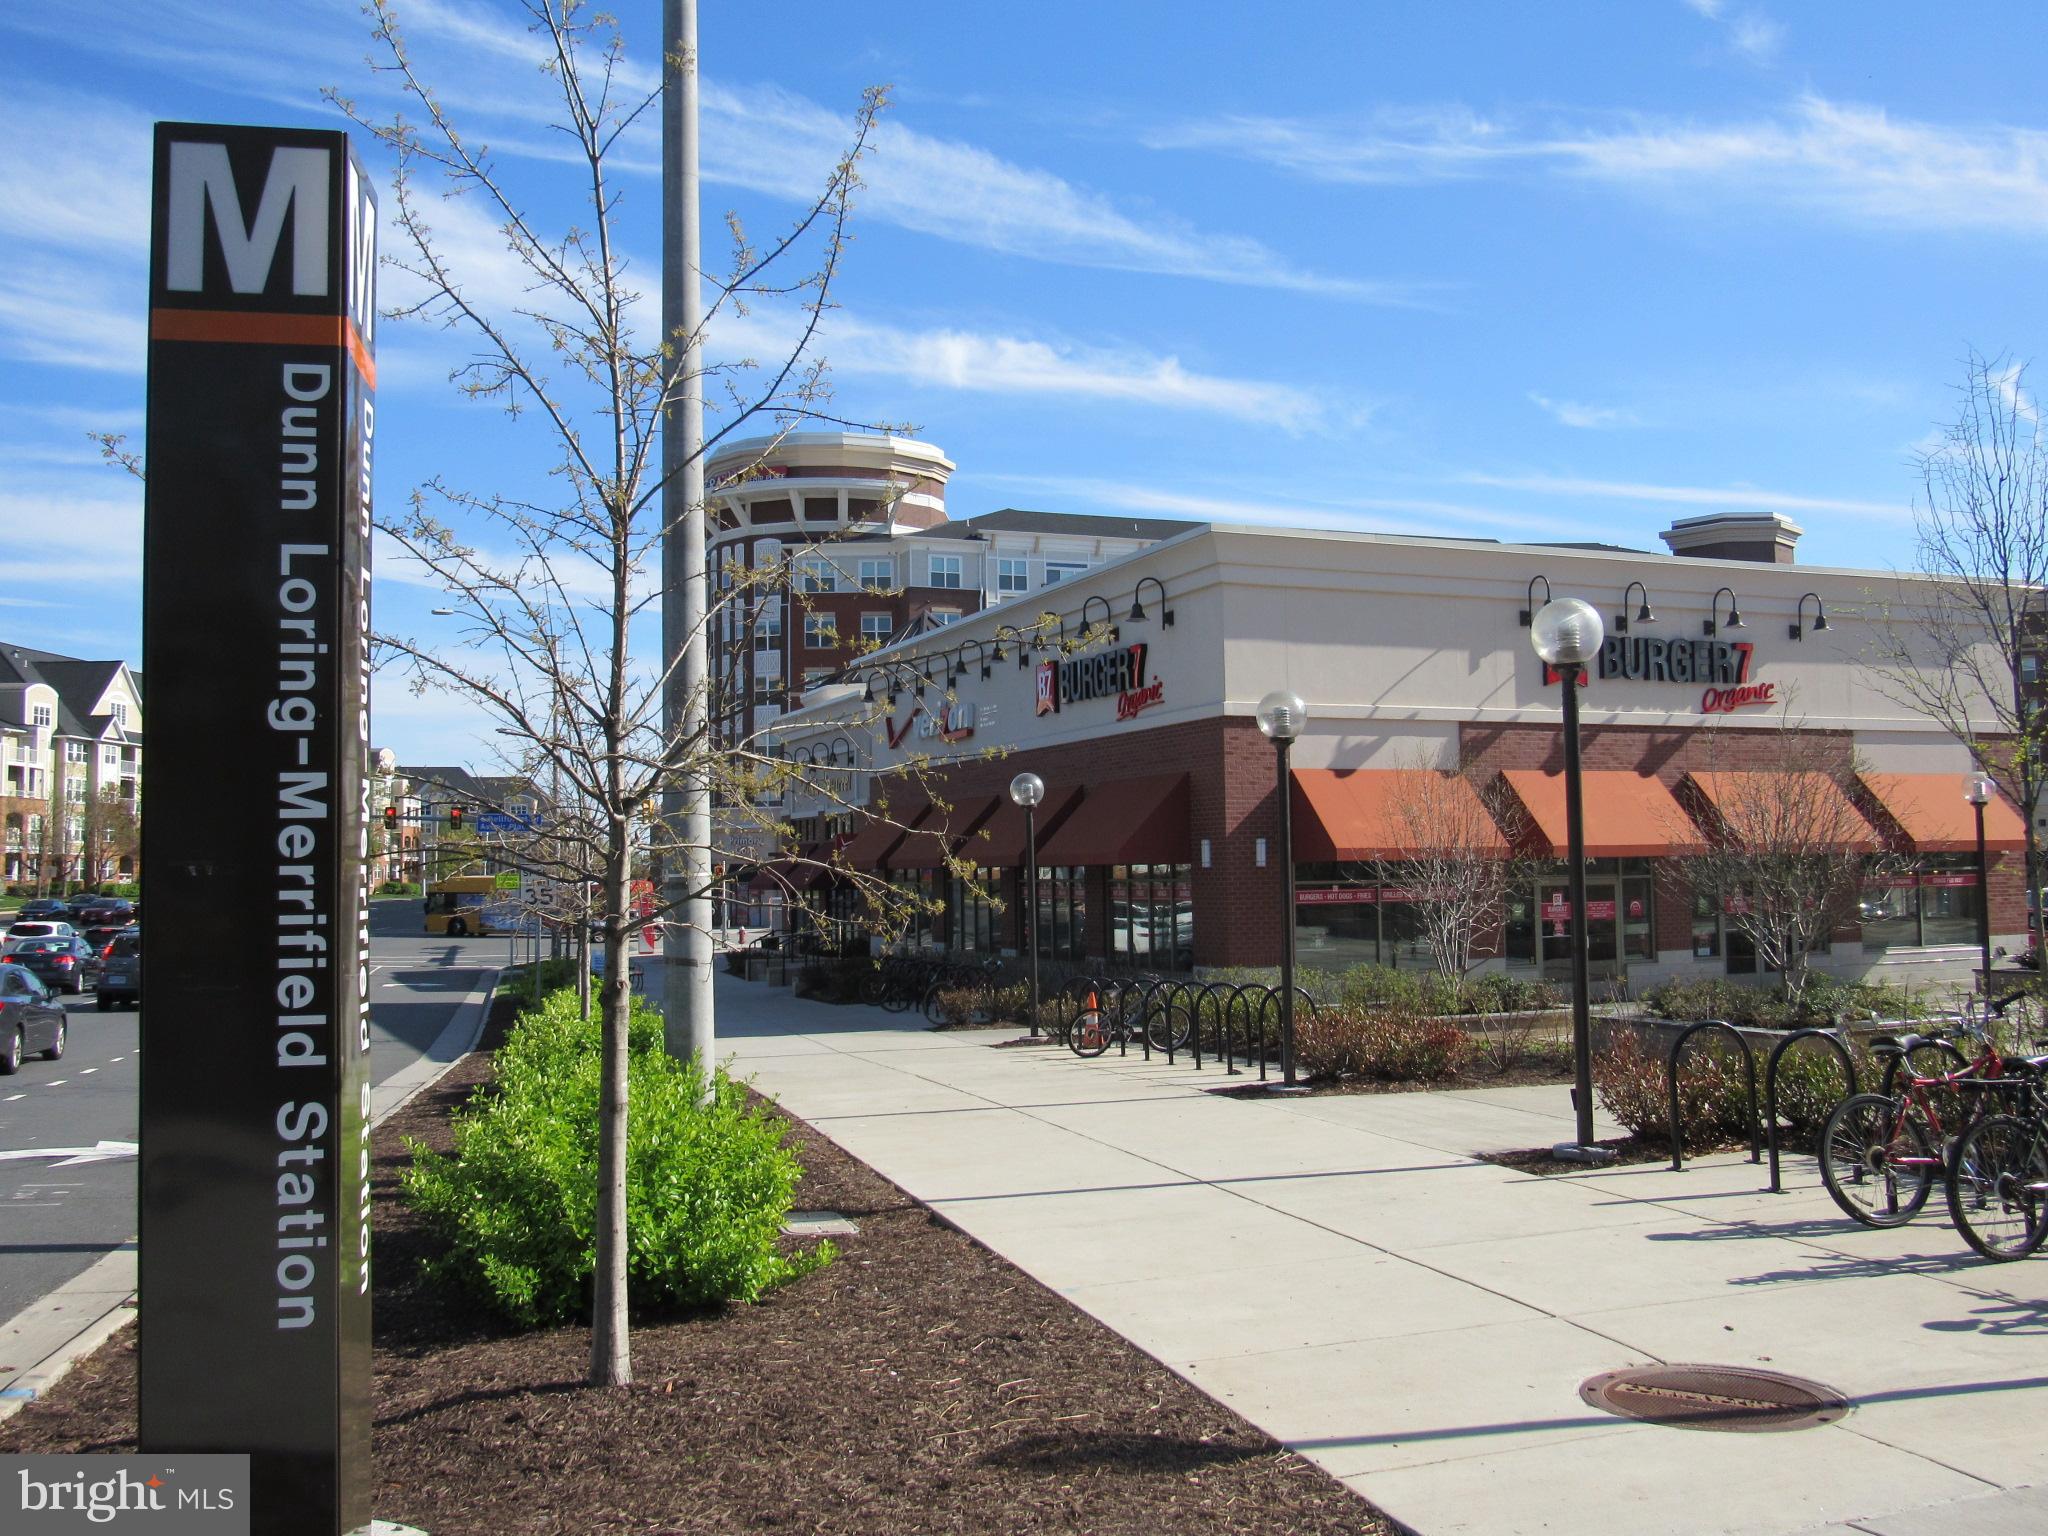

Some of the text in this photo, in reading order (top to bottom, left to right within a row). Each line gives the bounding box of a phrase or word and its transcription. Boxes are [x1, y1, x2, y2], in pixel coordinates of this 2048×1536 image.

[167, 141, 331, 297] M
[349, 159, 376, 343] M
[281, 363, 331, 511] Dunn
[360, 397, 375, 539] Dunn
[1702, 682, 1777, 713] Organic
[526, 888, 553, 905] 35
[276, 1100, 329, 1330] Station
[360, 1081, 372, 1296] Station
